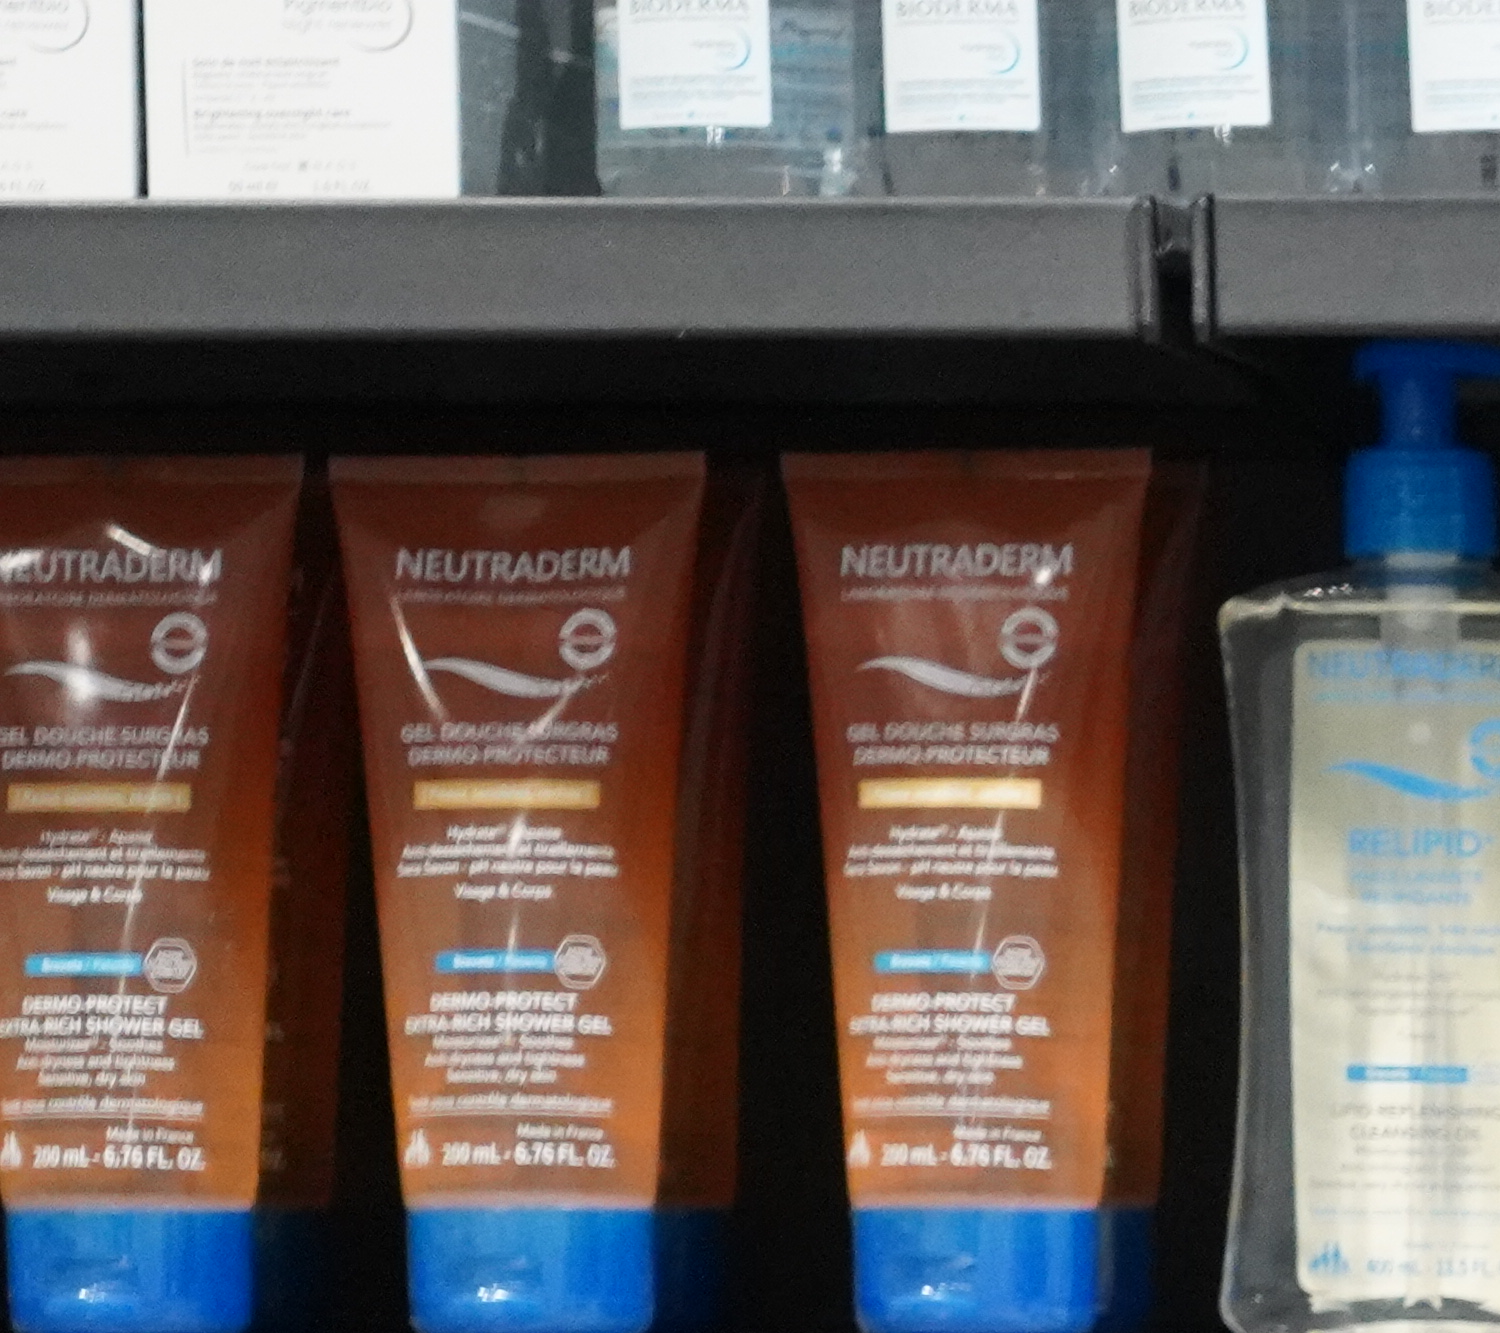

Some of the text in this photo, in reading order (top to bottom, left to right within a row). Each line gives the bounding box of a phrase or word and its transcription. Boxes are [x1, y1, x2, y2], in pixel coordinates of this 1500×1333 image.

[395, 547, 628, 583] NEUTRADERM
[841, 543, 1073, 577] NEUTRADERM
[85, 1015, 165, 1037] SHOWER
[168, 1018, 204, 1039] GEL
[495, 1013, 574, 1034] SHOWER
[578, 1015, 612, 1035] GEL
[1015, 1016, 1050, 1037] GEL
